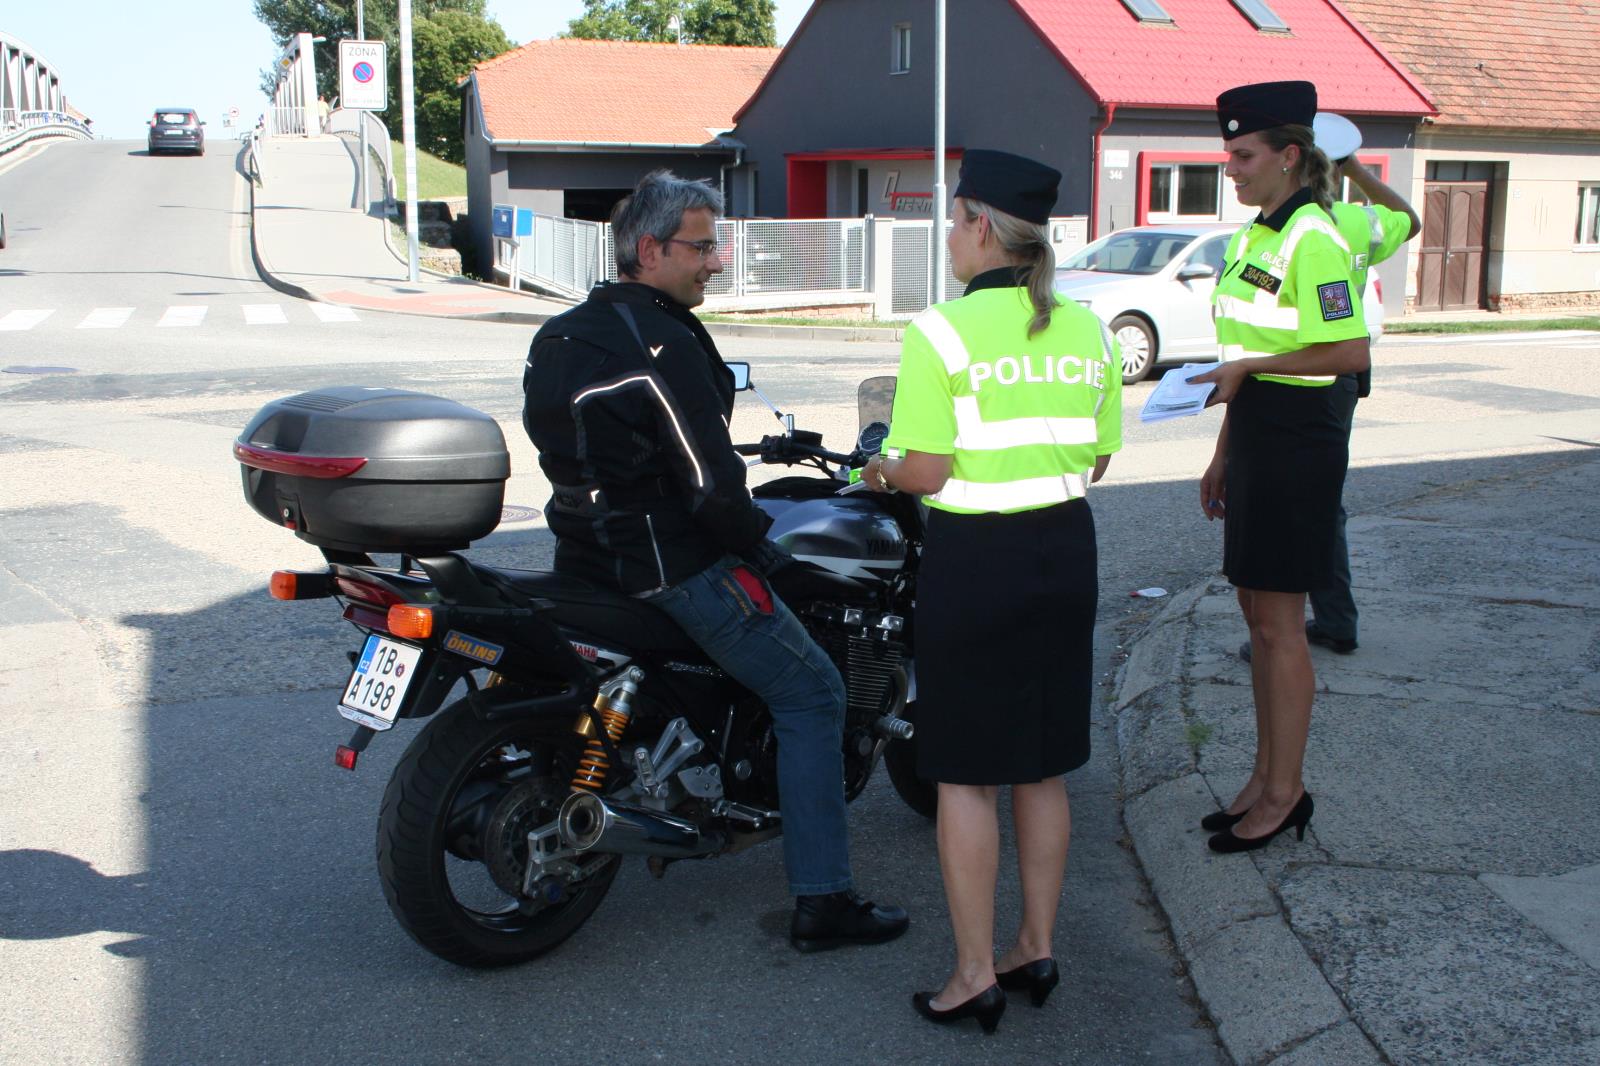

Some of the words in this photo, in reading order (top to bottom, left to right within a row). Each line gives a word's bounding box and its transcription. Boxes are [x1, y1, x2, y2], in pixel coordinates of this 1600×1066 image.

[349, 47, 377, 57] ZONA
[1326, 309, 1350, 318] POLICIE
[968, 354, 1105, 392] POLICIE
[447, 633, 497, 662] ÖHLINS
[361, 661, 370, 670] CZ
[376, 646, 398, 675] 1B
